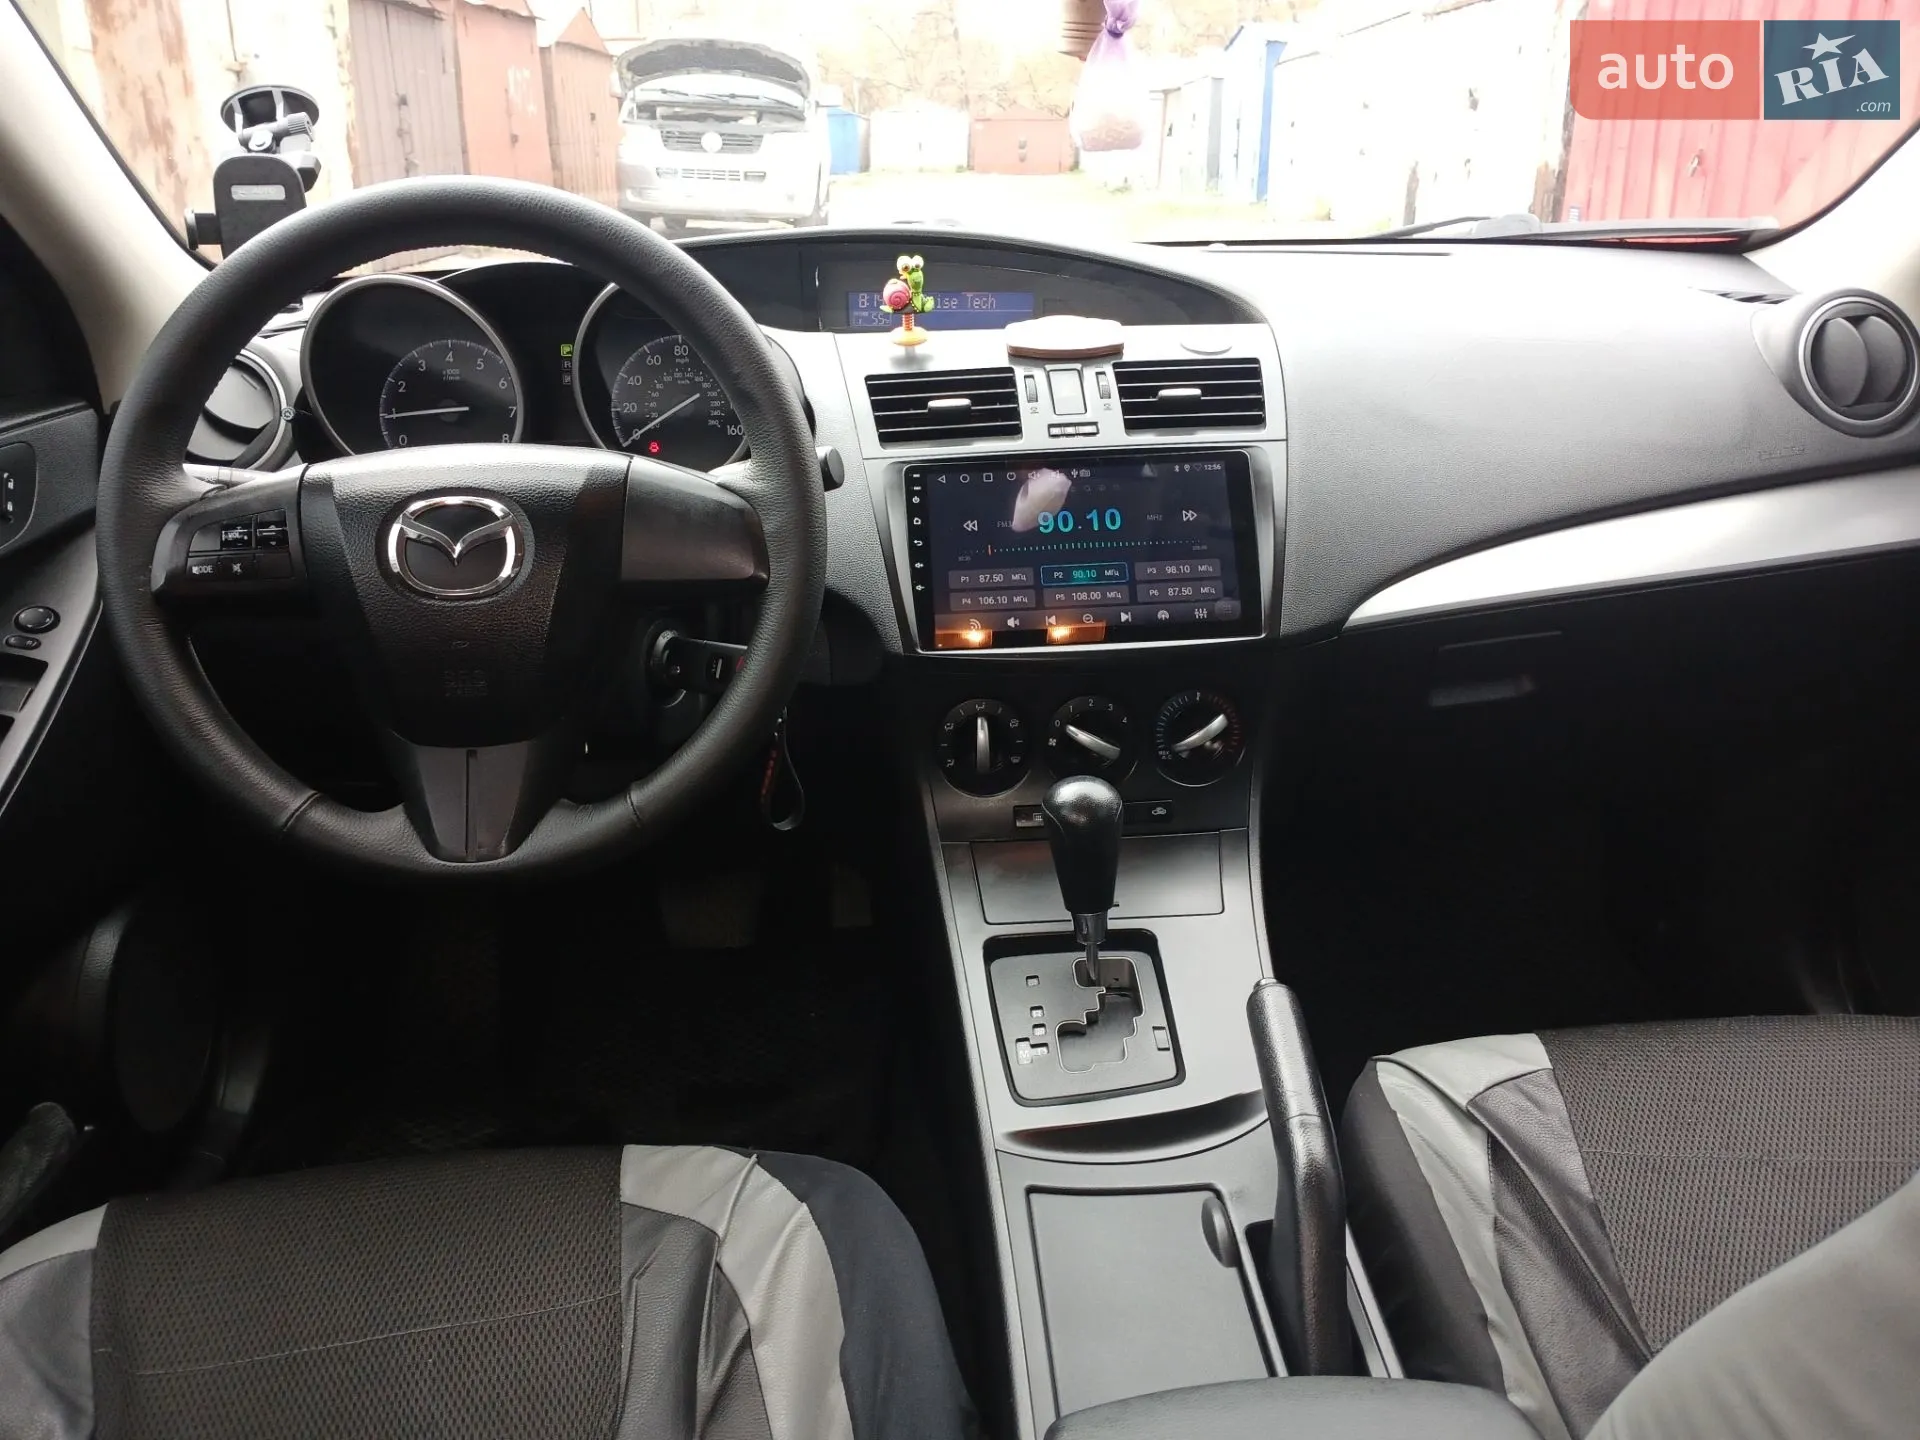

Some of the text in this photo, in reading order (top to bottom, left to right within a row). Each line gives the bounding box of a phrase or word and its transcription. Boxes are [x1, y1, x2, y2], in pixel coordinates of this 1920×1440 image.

[966, 293, 996, 309] Tech
[673, 344, 689, 356] 80
[445, 351, 454, 362] 4
[645, 354, 662, 366] 60
[418, 359, 426, 371] 3
[476, 358, 485, 370] 5
[398, 380, 407, 392] 2
[498, 377, 508, 389] 6
[626, 375, 642, 386] 40
[508, 406, 517, 418] 7
[622, 402, 638, 413] 20
[726, 424, 744, 436] 160
[399, 435, 407, 445] 0
[1037, 508, 1121, 534] 90.10
[1053, 571, 1064, 579] P2
[1072, 569, 1097, 579] 90.10
[1165, 565, 1191, 574] 98.10
[978, 573, 1004, 583] 87.50
[1055, 593, 1066, 601] P5
[1071, 591, 1102, 601] 108.00
[1167, 586, 1193, 596] 87.50
[961, 597, 972, 605] P4
[978, 595, 1008, 605] 106.10
[1088, 699, 1094, 707] 2
[1107, 703, 1114, 711] 3
[1054, 718, 1061, 727] 0
[1122, 716, 1128, 724] 4
